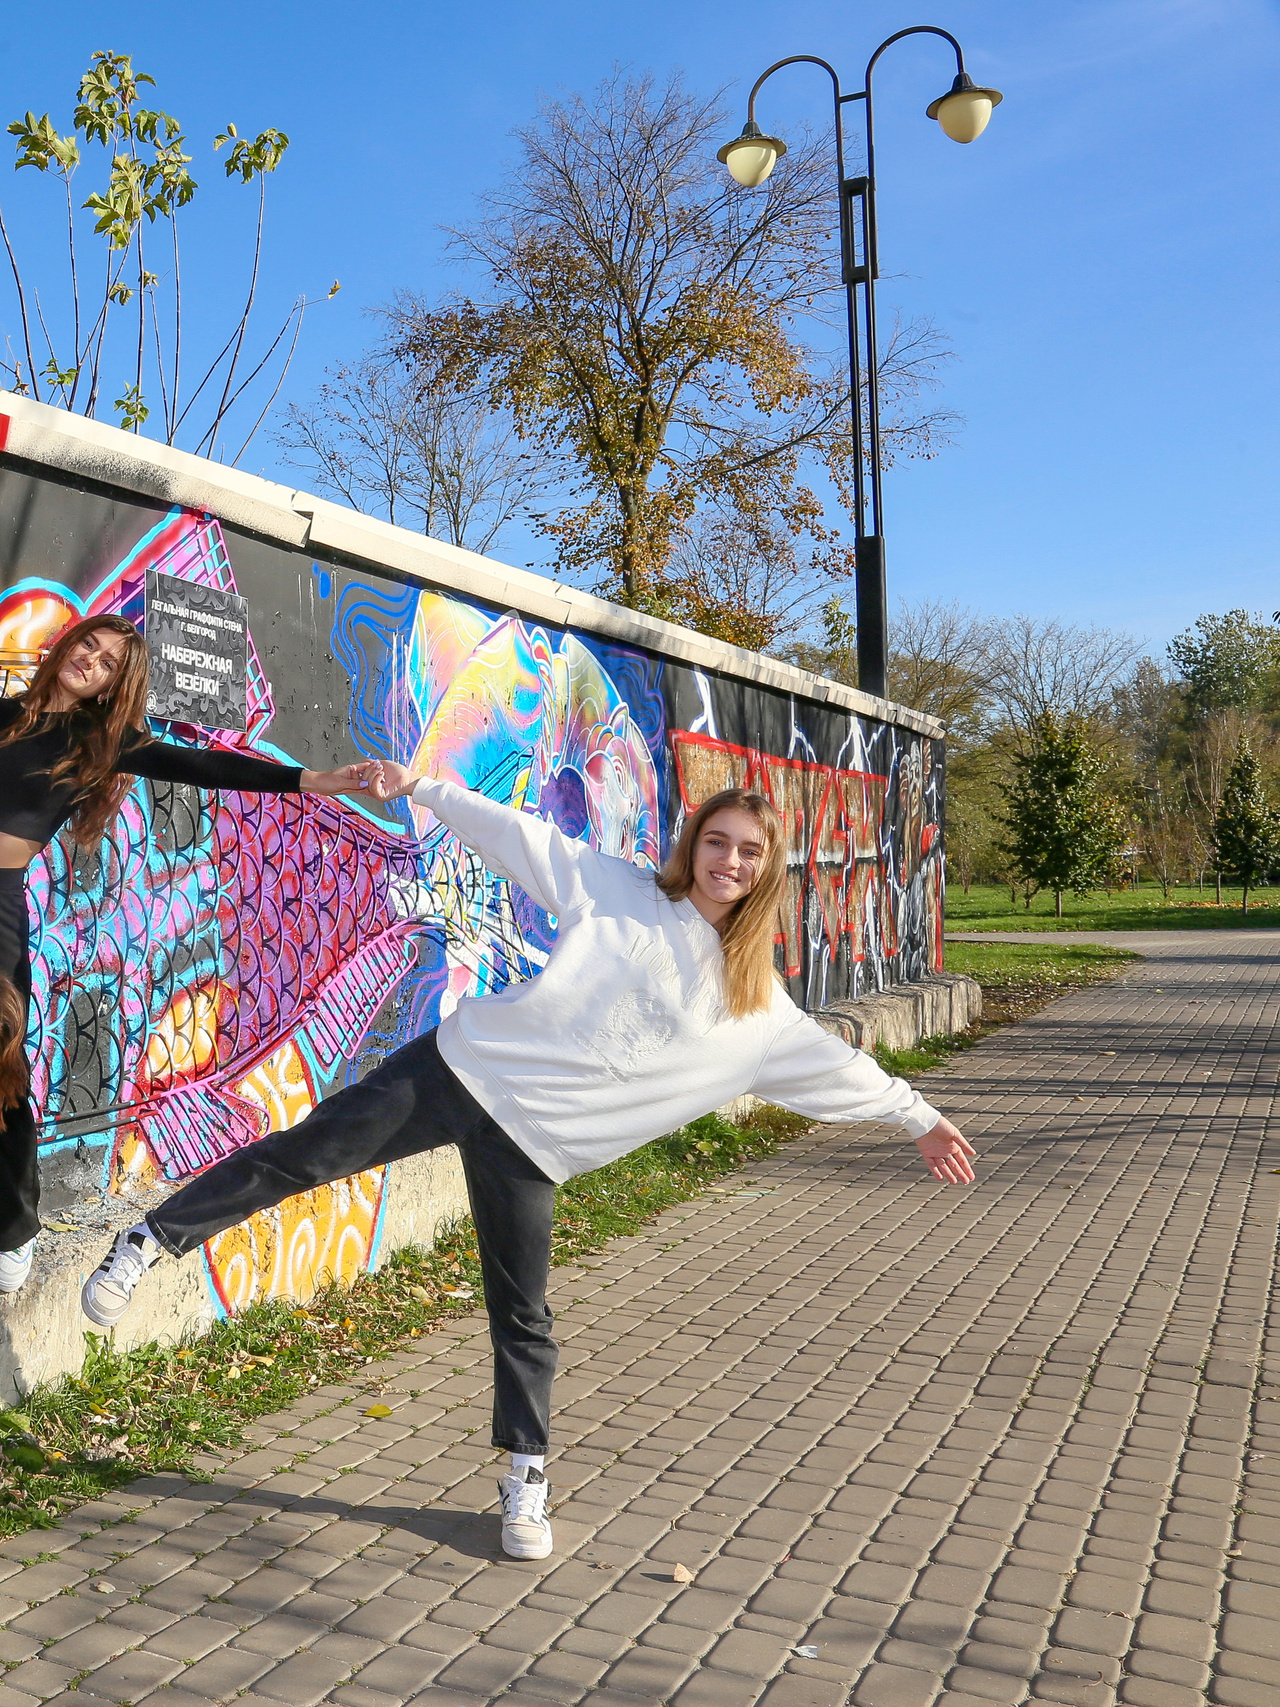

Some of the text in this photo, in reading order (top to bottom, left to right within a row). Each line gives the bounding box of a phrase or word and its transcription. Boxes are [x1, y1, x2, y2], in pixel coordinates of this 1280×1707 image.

[151, 599, 243, 634] ЛЕГАЛЬНАЯ ГРАФФИТИ СТЕНА
[180, 621, 217, 642] Г. БЕЛГОРОД
[161, 642, 233, 675] НАБЕРЕЖНАЯ
[175, 671, 220, 697] ВЕЗЁЛКИ
